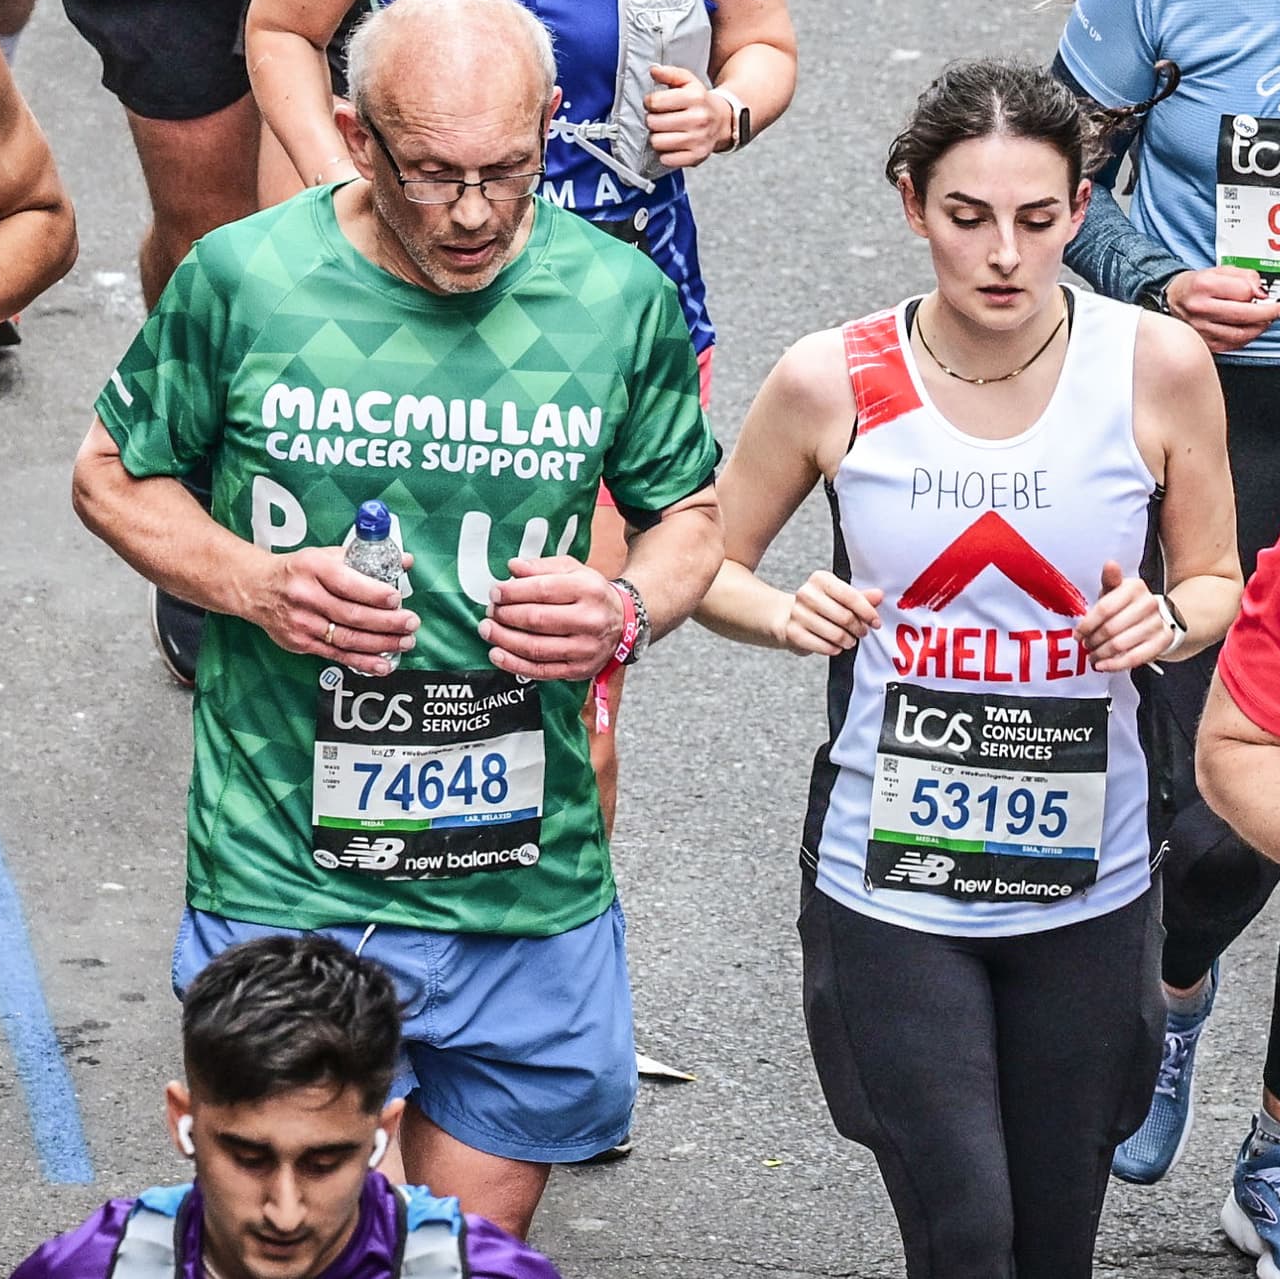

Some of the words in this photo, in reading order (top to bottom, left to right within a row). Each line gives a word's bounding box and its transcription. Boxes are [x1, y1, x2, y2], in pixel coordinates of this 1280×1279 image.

[261, 382, 604, 449] MACMILLAN
[265, 431, 412, 469] CANCER
[420, 441, 586, 482] SUPPORT
[909, 466, 1052, 511] PHOEBE
[422, 688, 526, 716] CONSULTANCY
[423, 684, 474, 699] TATA
[333, 684, 413, 733] tcs
[983, 705, 1033, 725] TATA
[421, 713, 491, 733] SERVICES
[895, 693, 973, 753] tcs
[982, 724, 1094, 743] CONSULTANCY
[979, 742, 1053, 761] SERVICES
[353, 752, 509, 812] 74648
[910, 778, 1069, 839] 53195
[404, 856, 446, 871] new
[446, 846, 521, 868] balance
[953, 877, 990, 894] new
[994, 877, 1073, 897] balance
